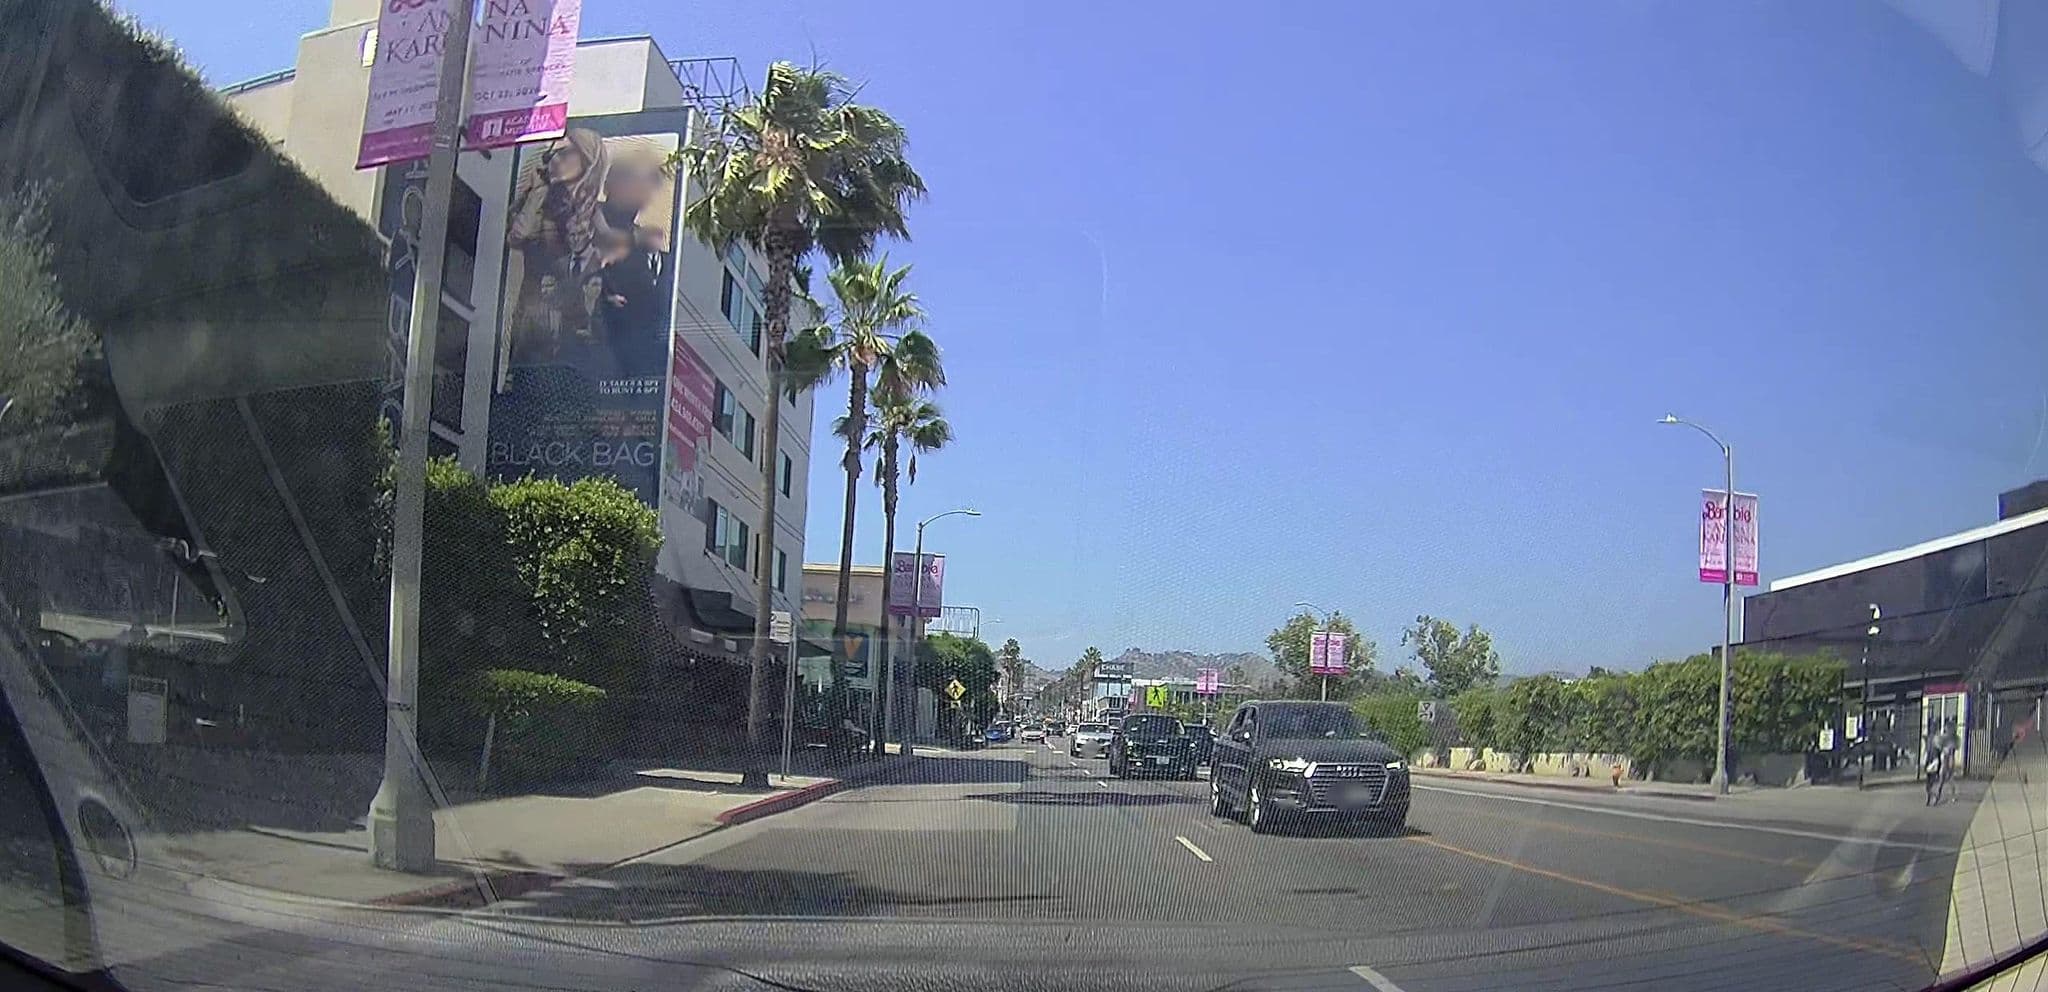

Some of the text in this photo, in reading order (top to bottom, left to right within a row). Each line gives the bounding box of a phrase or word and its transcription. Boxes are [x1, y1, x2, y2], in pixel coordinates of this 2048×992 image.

[483, 15, 571, 44] NINA
[491, 441, 654, 467] BLACK BAG
